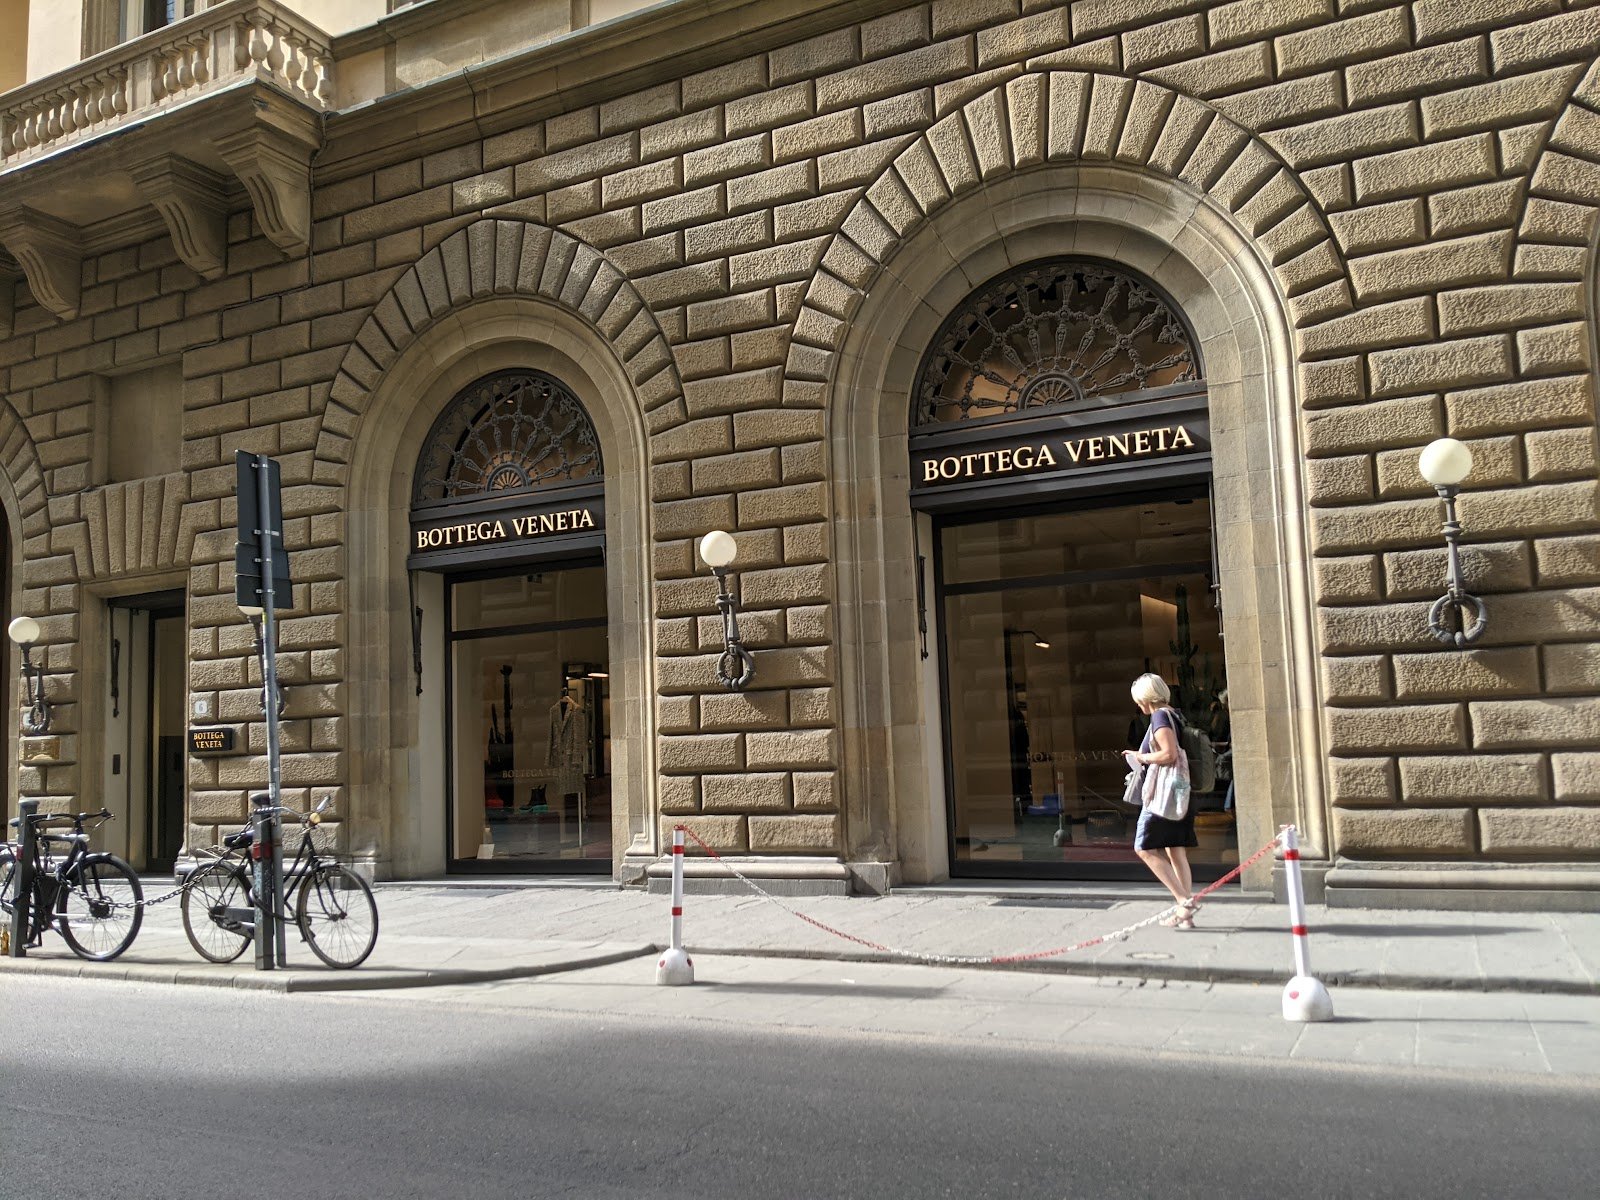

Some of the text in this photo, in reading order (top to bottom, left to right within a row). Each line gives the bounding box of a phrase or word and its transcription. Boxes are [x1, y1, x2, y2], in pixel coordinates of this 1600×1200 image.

[922, 425, 1194, 482] BOTTEGA VENETA
[416, 508, 595, 549] BOTTEGA VENETA
[193, 731, 225, 740] BOTTEGA
[196, 740, 223, 749] VENETA
